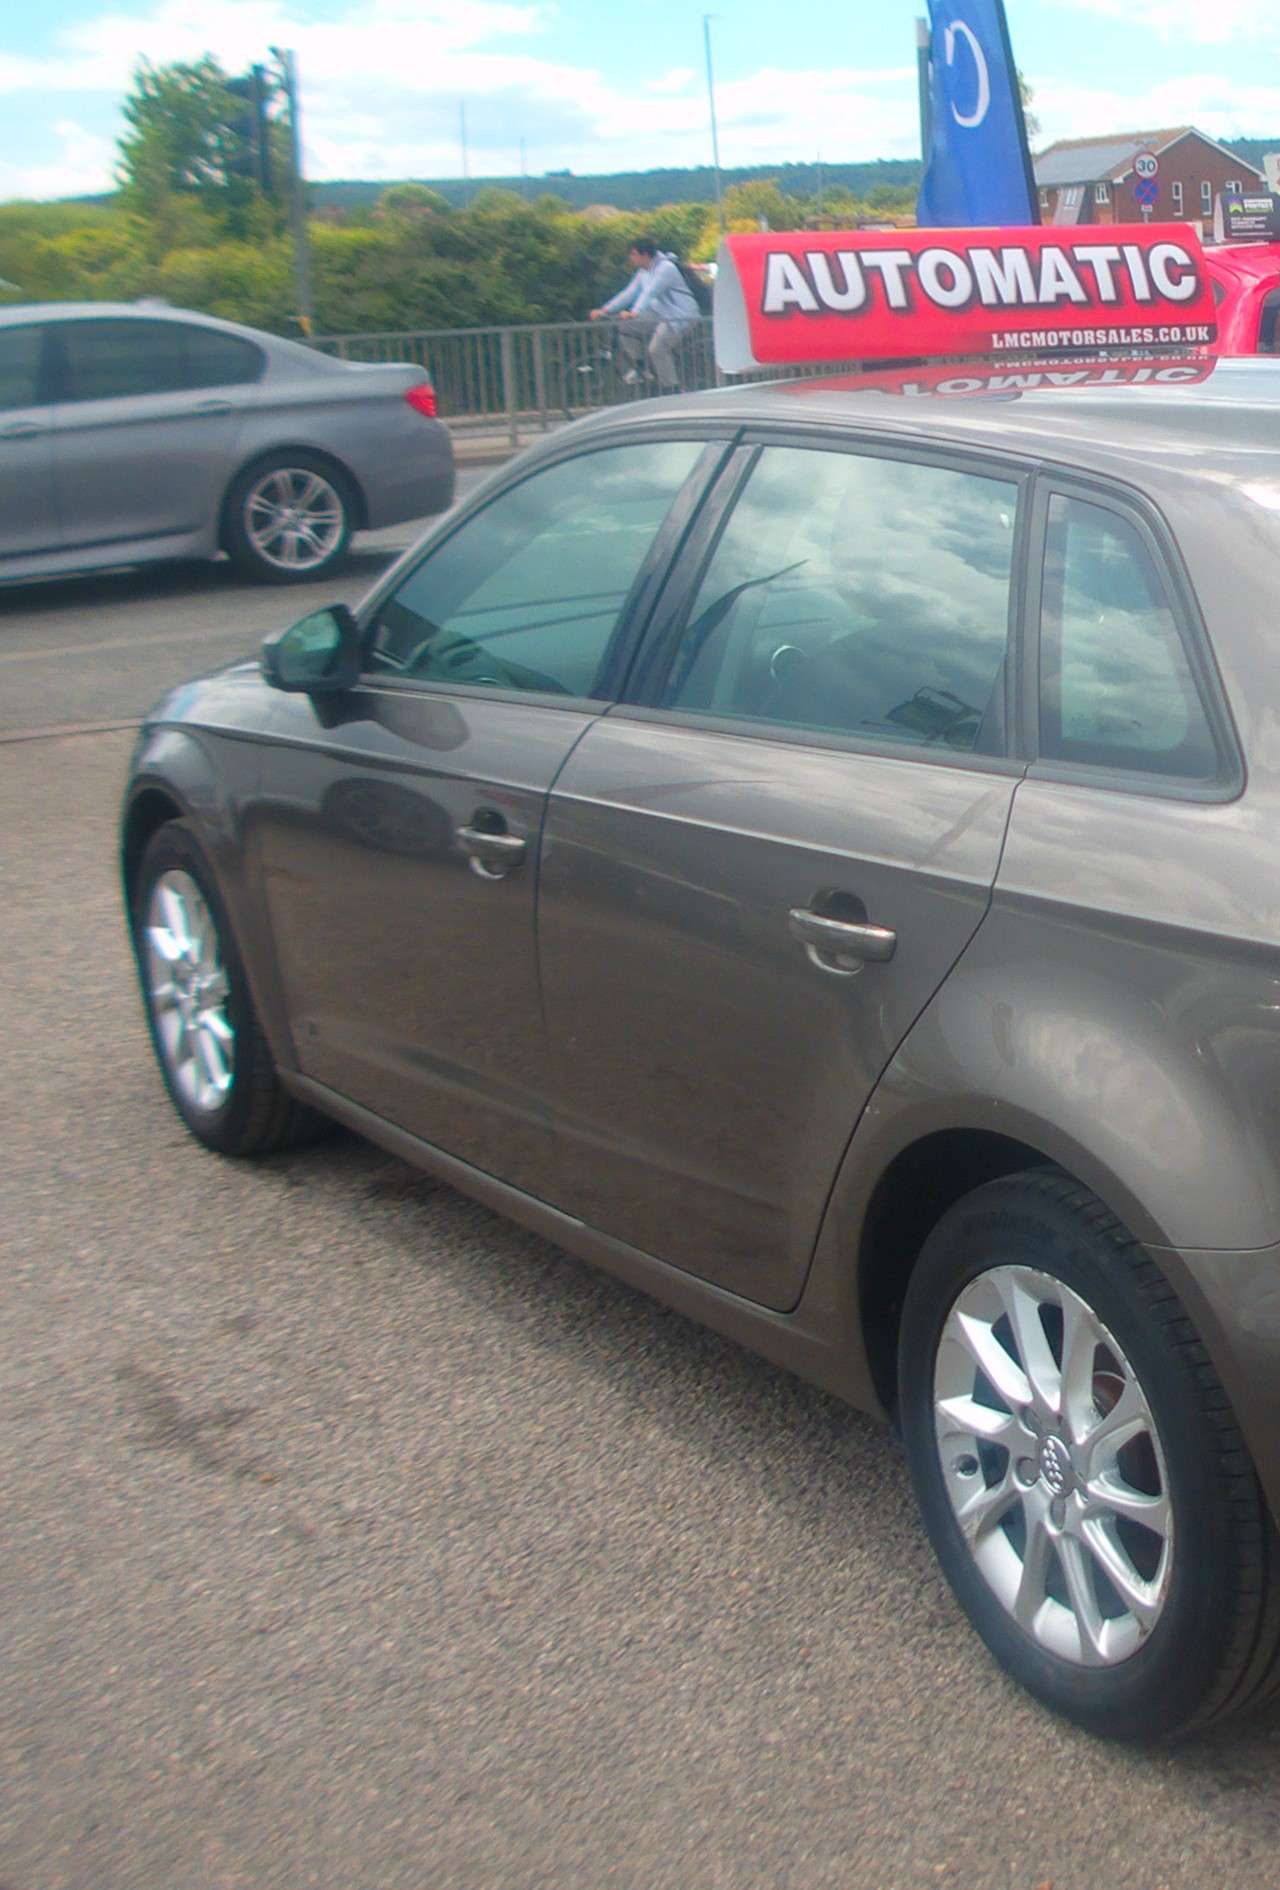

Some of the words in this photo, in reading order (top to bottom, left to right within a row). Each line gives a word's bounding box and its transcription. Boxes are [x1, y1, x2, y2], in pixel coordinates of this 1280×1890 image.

[1137, 160, 1156, 173] 30
[763, 244, 1197, 312] AUTOMATIC
[991, 325, 1210, 349] LMCMOTORSALES.CO.UK
